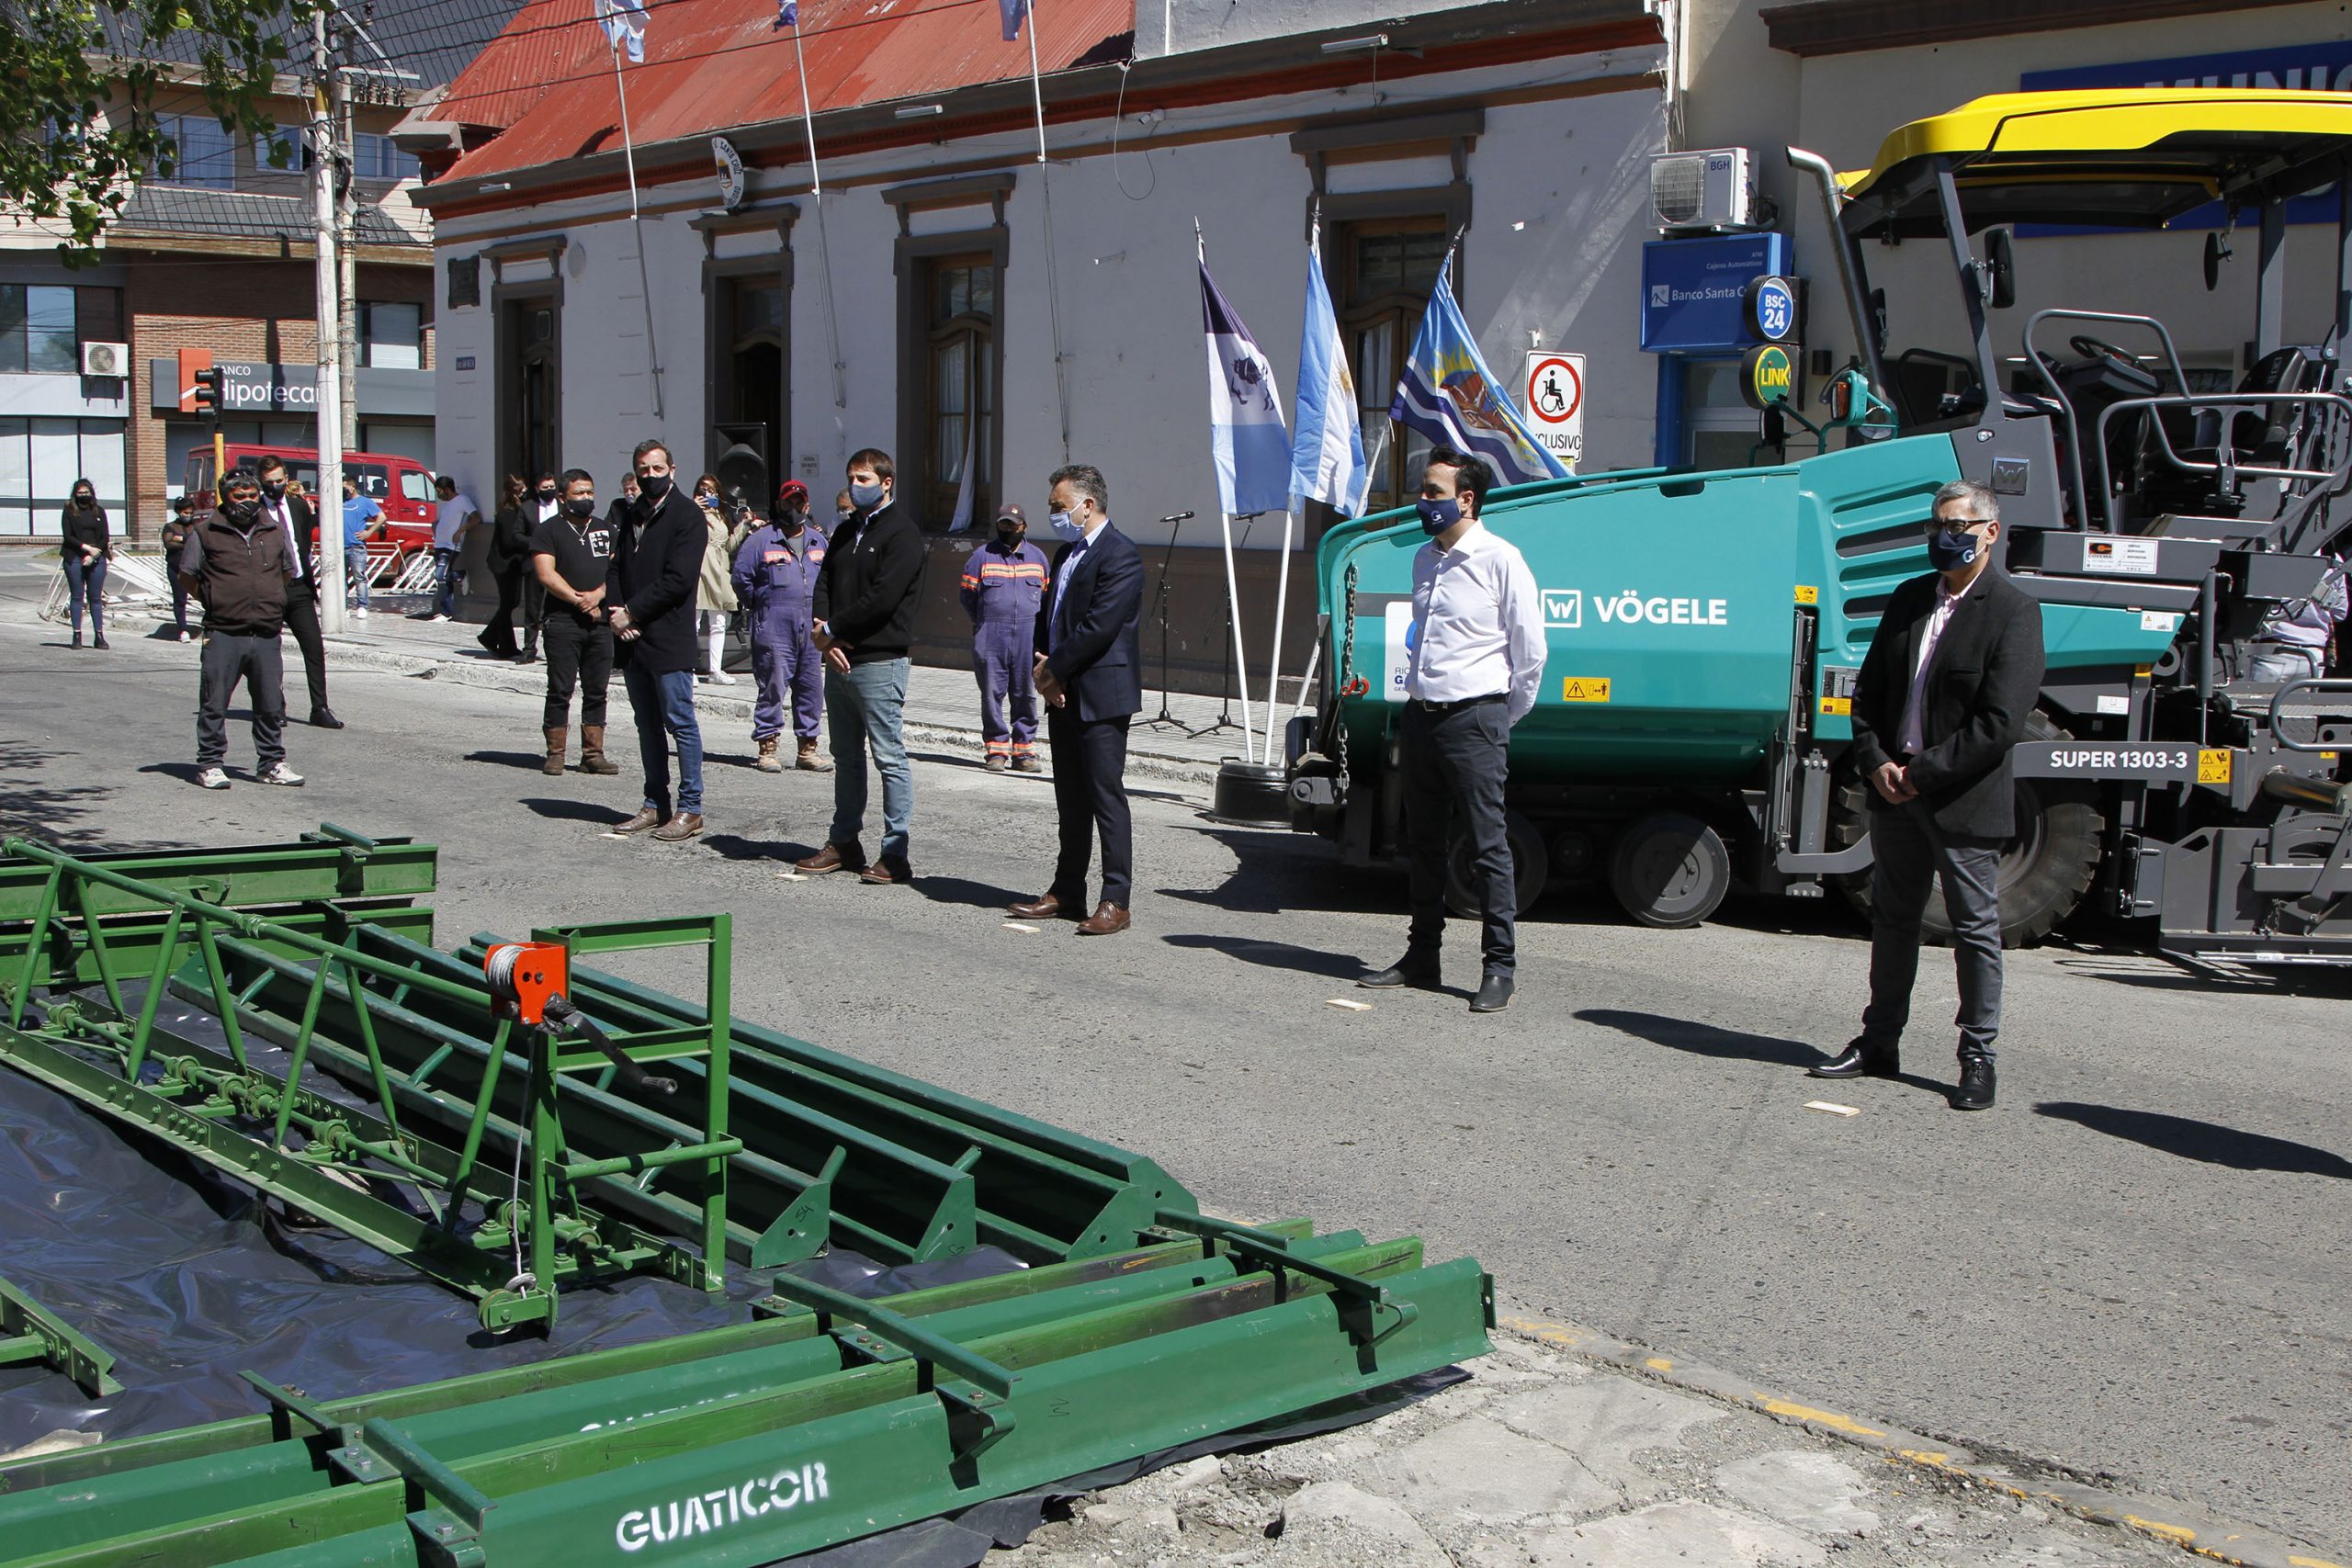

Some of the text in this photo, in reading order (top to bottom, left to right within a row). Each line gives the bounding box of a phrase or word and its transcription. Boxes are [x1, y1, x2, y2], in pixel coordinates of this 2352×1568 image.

[1710, 160, 1730, 171] BGH
[1672, 288, 1703, 301] Banco
[1705, 287, 1736, 299] Santa
[1765, 294, 1785, 309] BSC
[1764, 309, 1785, 330] 24
[1761, 367, 1790, 387] LINK
[1535, 433, 1582, 451] CLUSIVO
[1593, 590, 1727, 626] VÖGELE
[2050, 750, 2188, 769] SUPER 1303-3
[616, 1461, 829, 1551] GUATICOR
